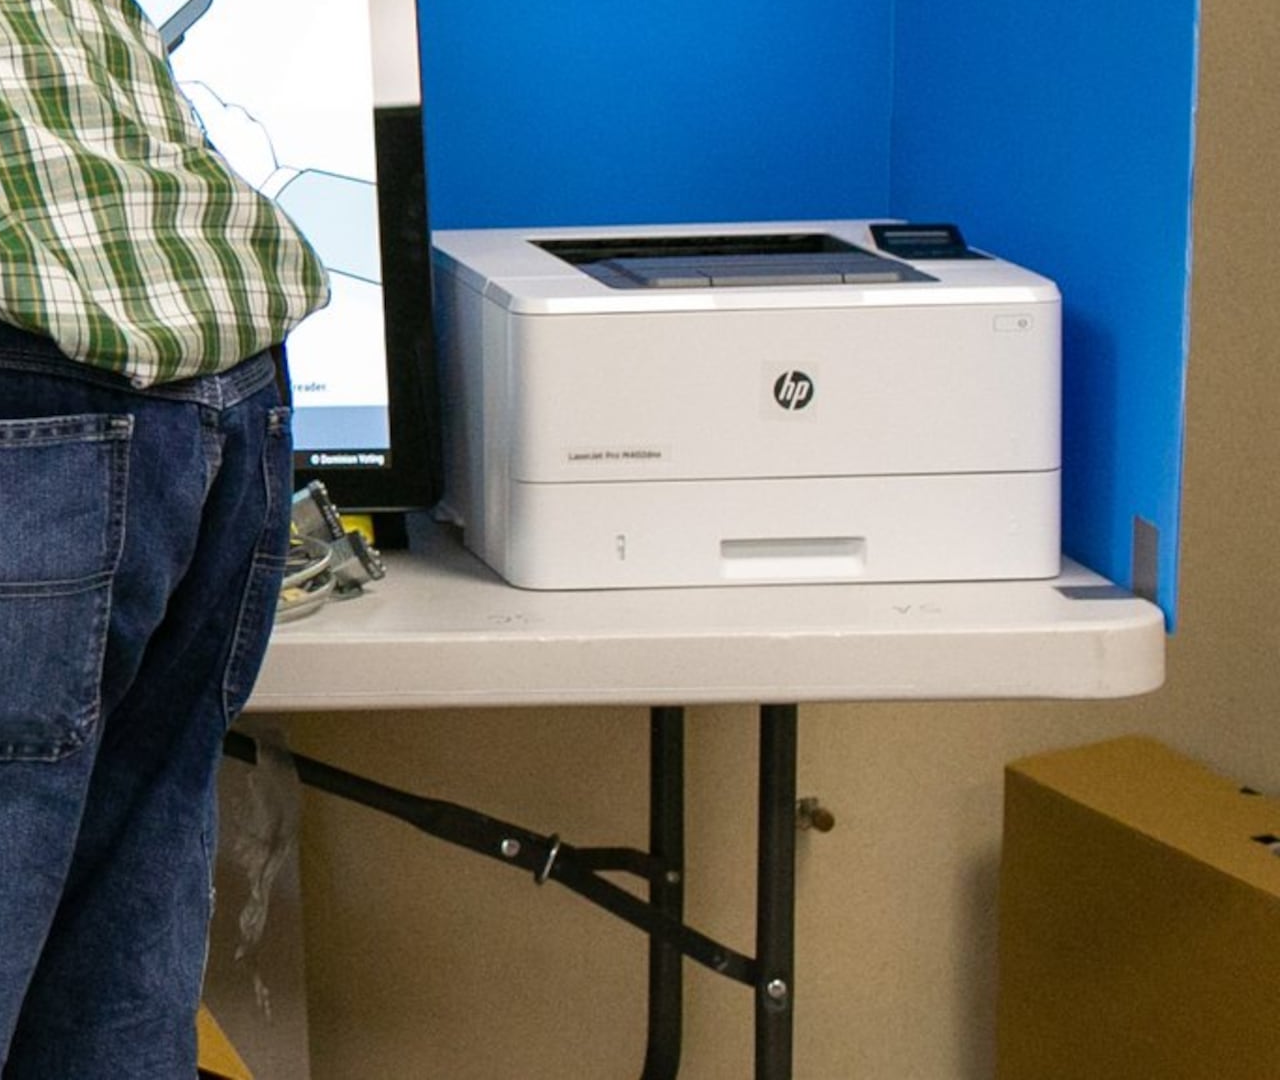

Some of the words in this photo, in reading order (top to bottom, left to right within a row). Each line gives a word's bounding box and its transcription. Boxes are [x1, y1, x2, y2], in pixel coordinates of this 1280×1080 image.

[777, 370, 811, 410] hp
[320, 453, 358, 465] Dominion
[358, 452, 385, 467] Voting
